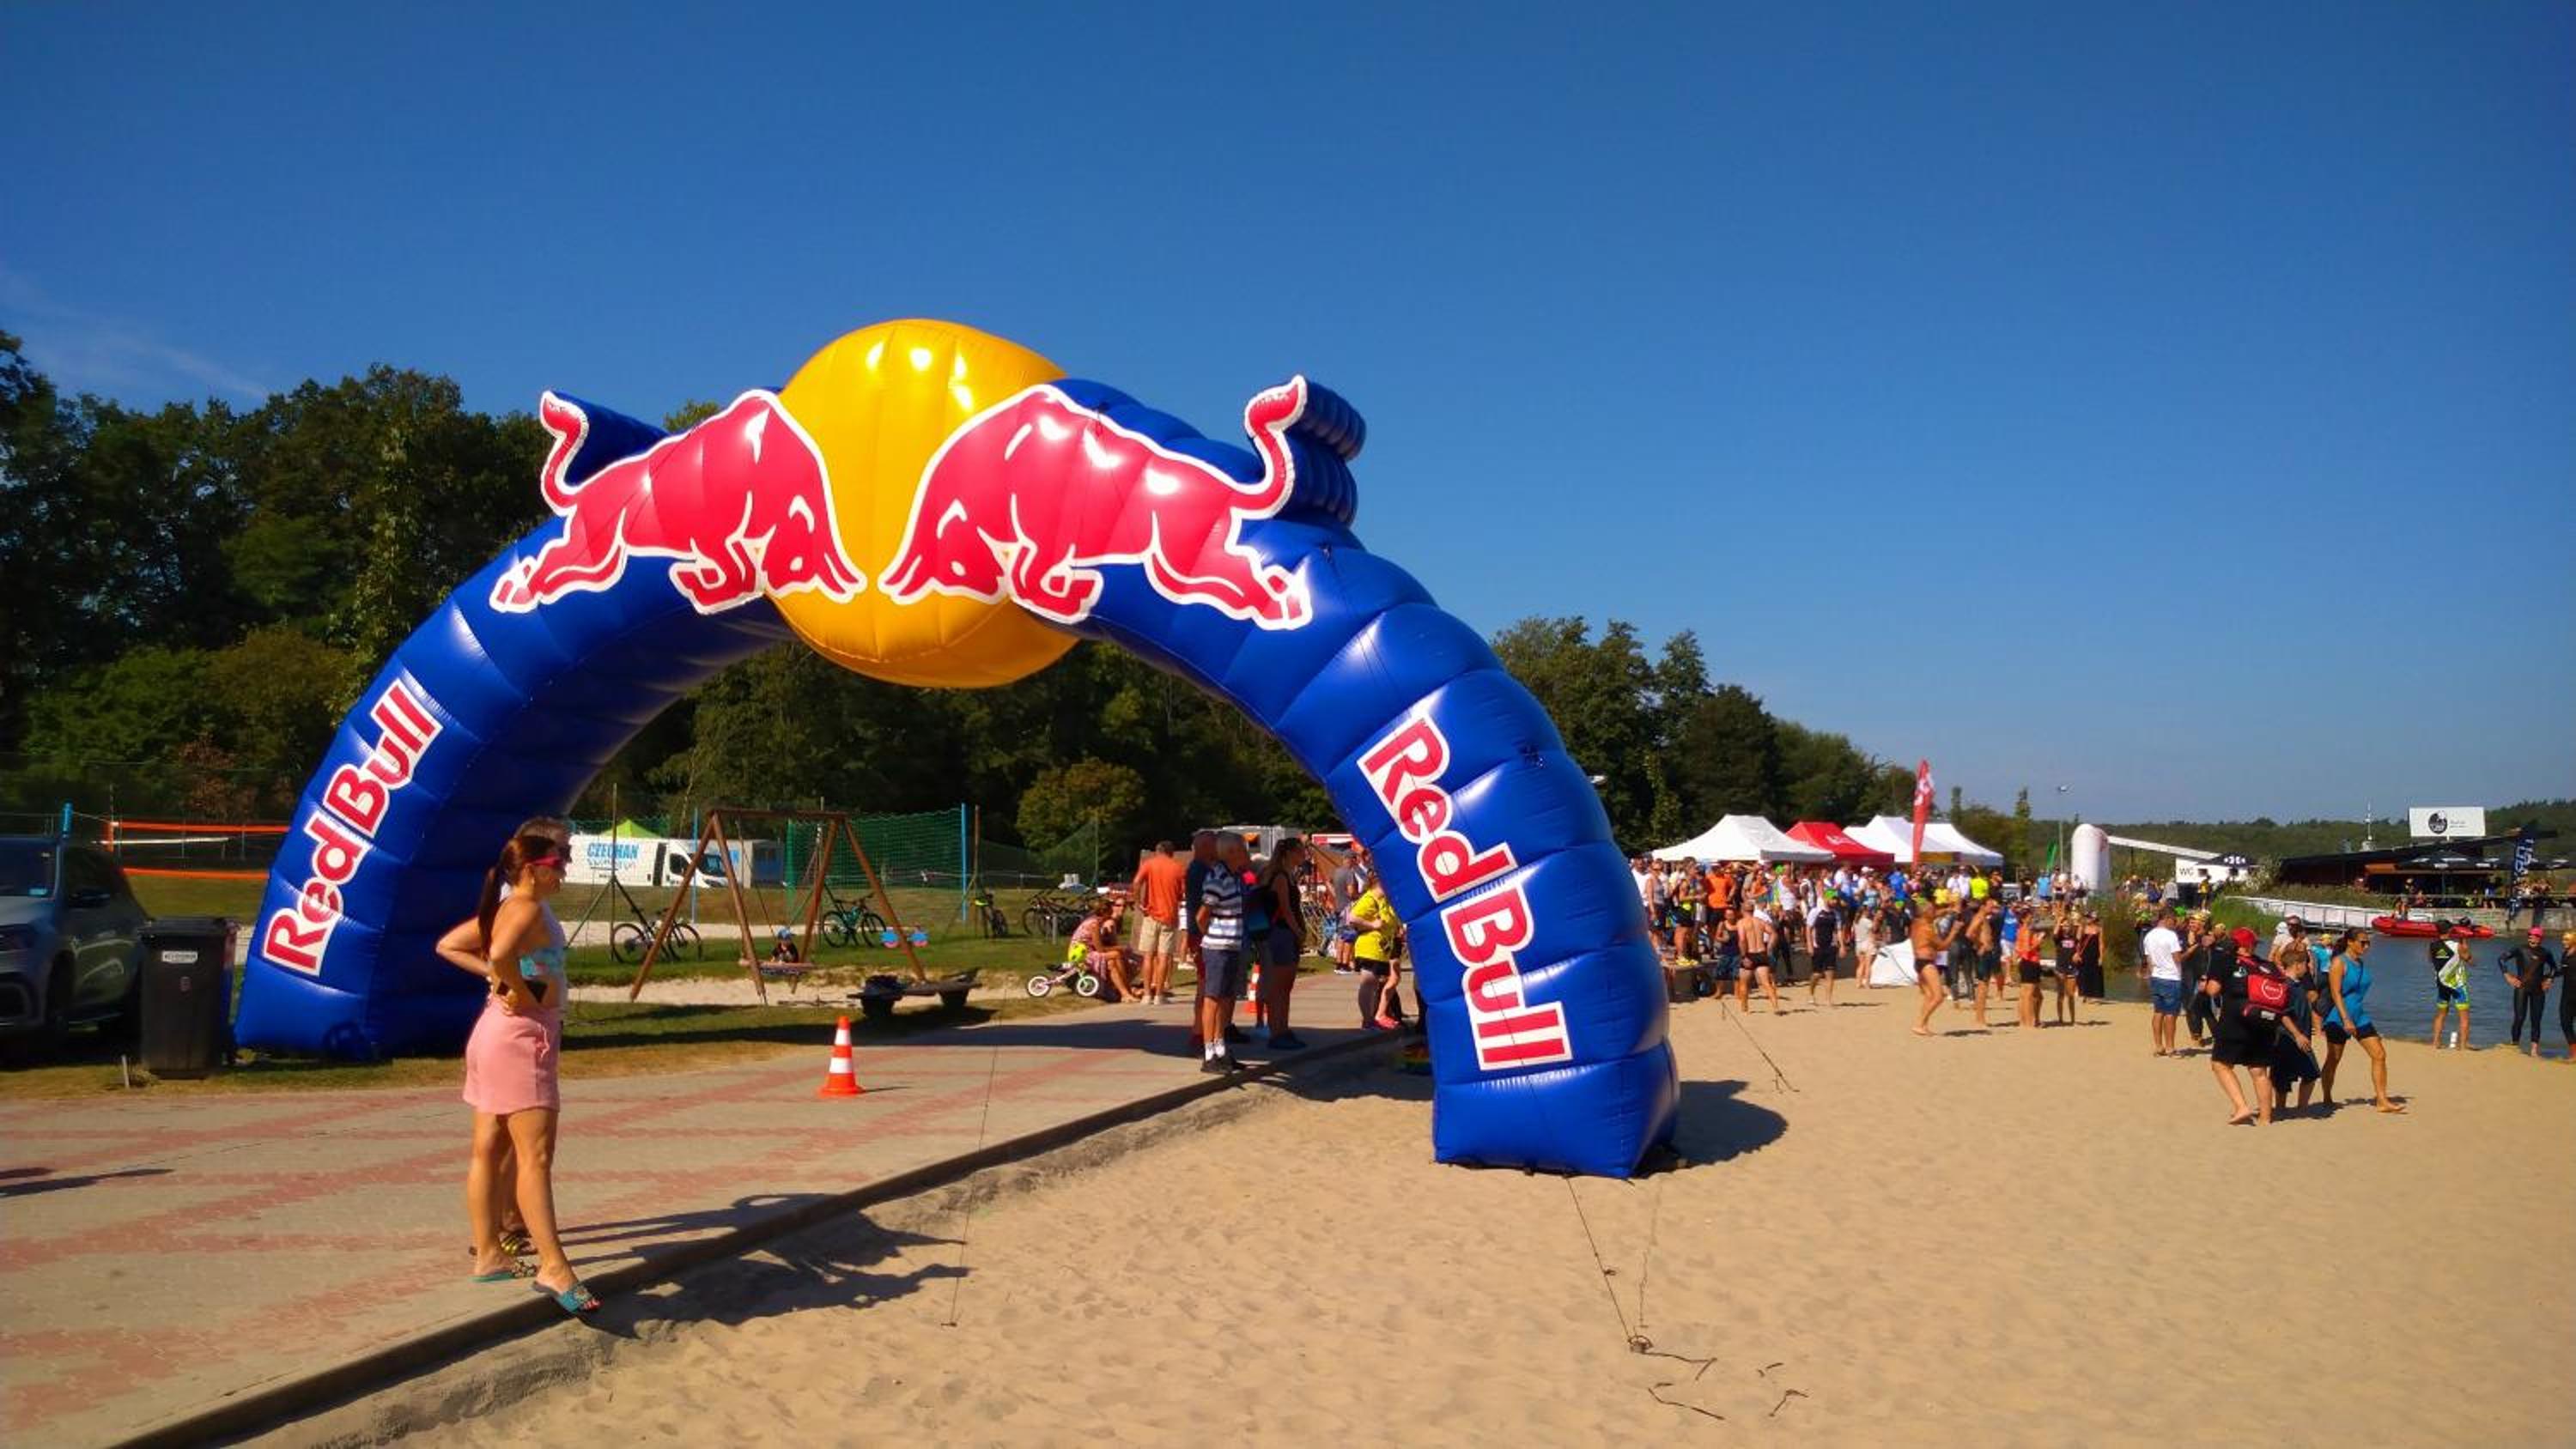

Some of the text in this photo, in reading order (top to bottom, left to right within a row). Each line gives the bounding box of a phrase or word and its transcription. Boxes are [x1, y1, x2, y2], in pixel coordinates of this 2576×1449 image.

[262, 677, 443, 977] Red Bull
[1357, 713, 1573, 1071] Red Bull
[2179, 866, 2194, 876] WC
